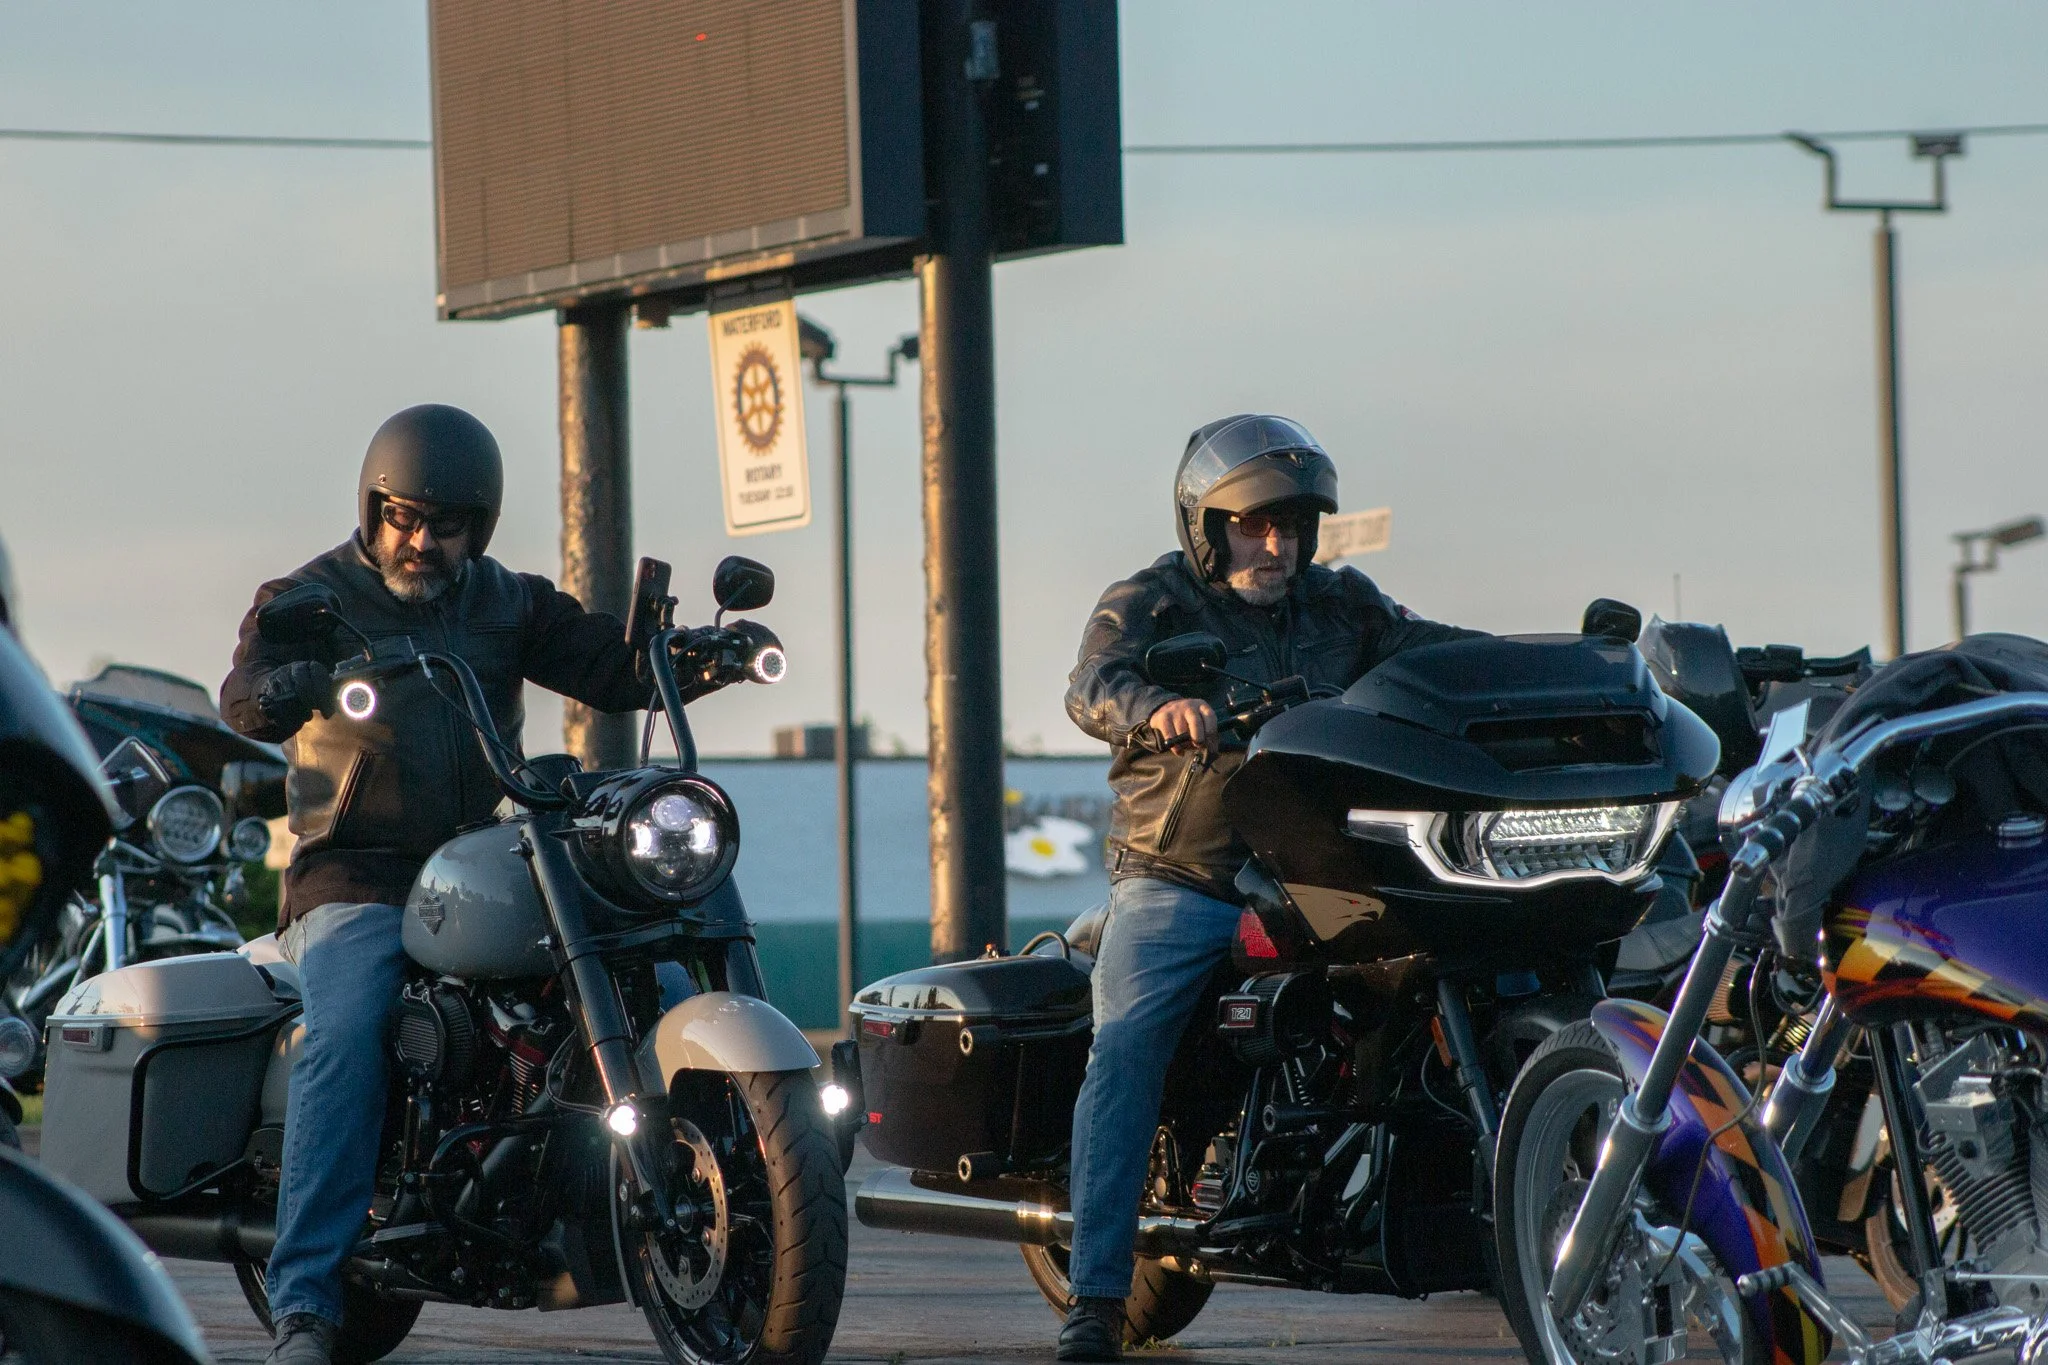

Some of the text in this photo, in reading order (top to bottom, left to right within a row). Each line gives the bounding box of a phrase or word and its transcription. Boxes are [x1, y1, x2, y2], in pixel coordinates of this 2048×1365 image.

[722, 309, 782, 336] WATERFORD
[745, 464, 782, 483] ROTARY
[1231, 1007, 1252, 1020] 121
[868, 1112, 883, 1124] ST
